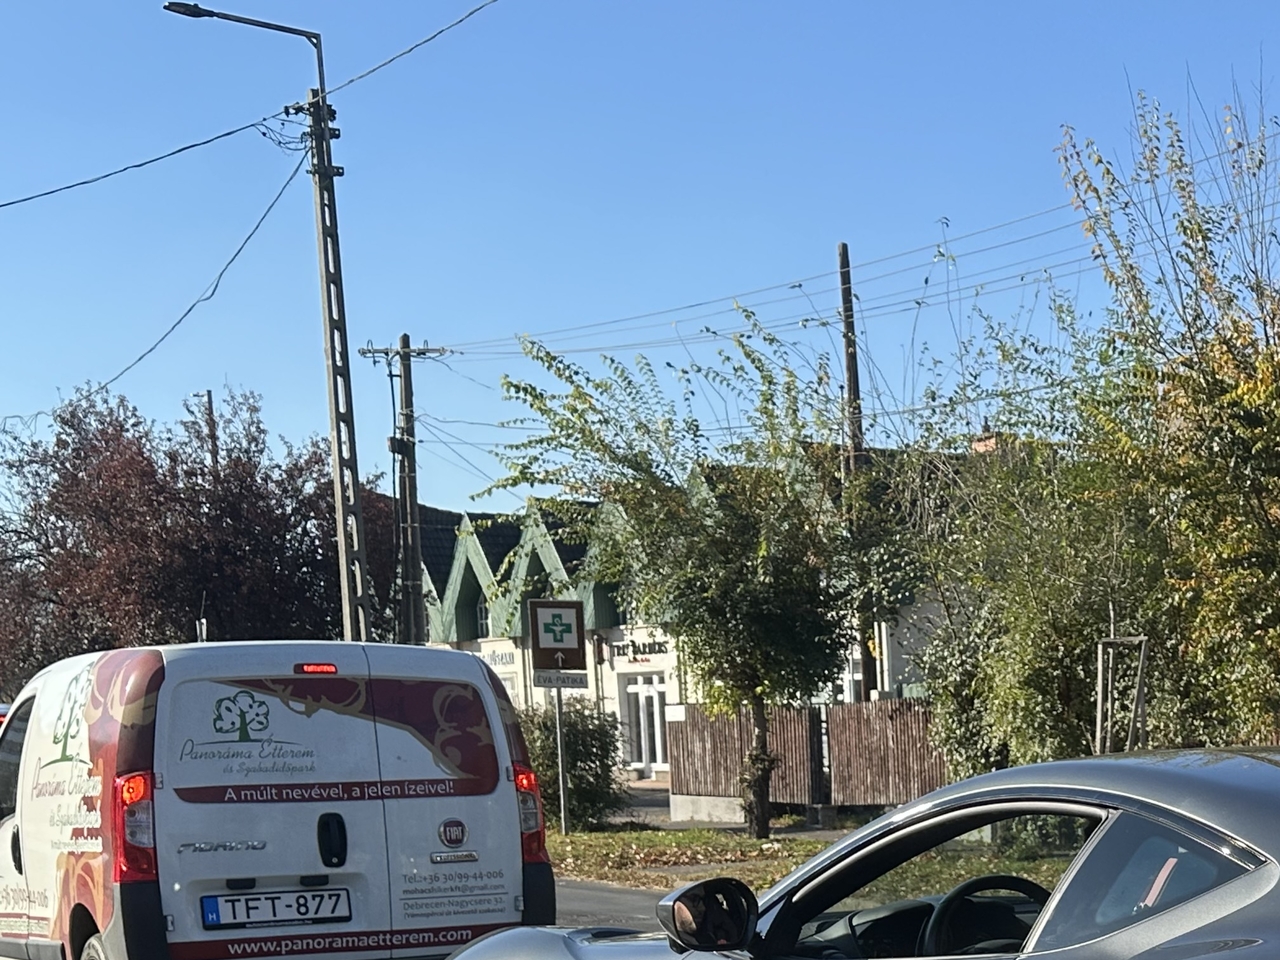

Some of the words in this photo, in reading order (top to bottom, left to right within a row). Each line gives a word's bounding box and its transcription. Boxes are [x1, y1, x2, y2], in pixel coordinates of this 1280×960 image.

[537, 674, 584, 685] ÉVA-PATIKA
[180, 739, 253, 762] Panoráma
[258, 733, 315, 759] Étterem
[224, 788, 237, 801] A
[241, 786, 278, 800] múlt
[282, 784, 347, 800] nevével,
[352, 786, 360, 797] a
[364, 783, 401, 800] jelen
[404, 781, 454, 795] ízeivel!
[445, 826, 463, 841] FIAT
[442, 869, 504, 883] 30/99-44-006
[224, 893, 342, 920] TFT-877
[208, 913, 217, 922] H
[227, 928, 473, 956] www.panoramaetterem.com
